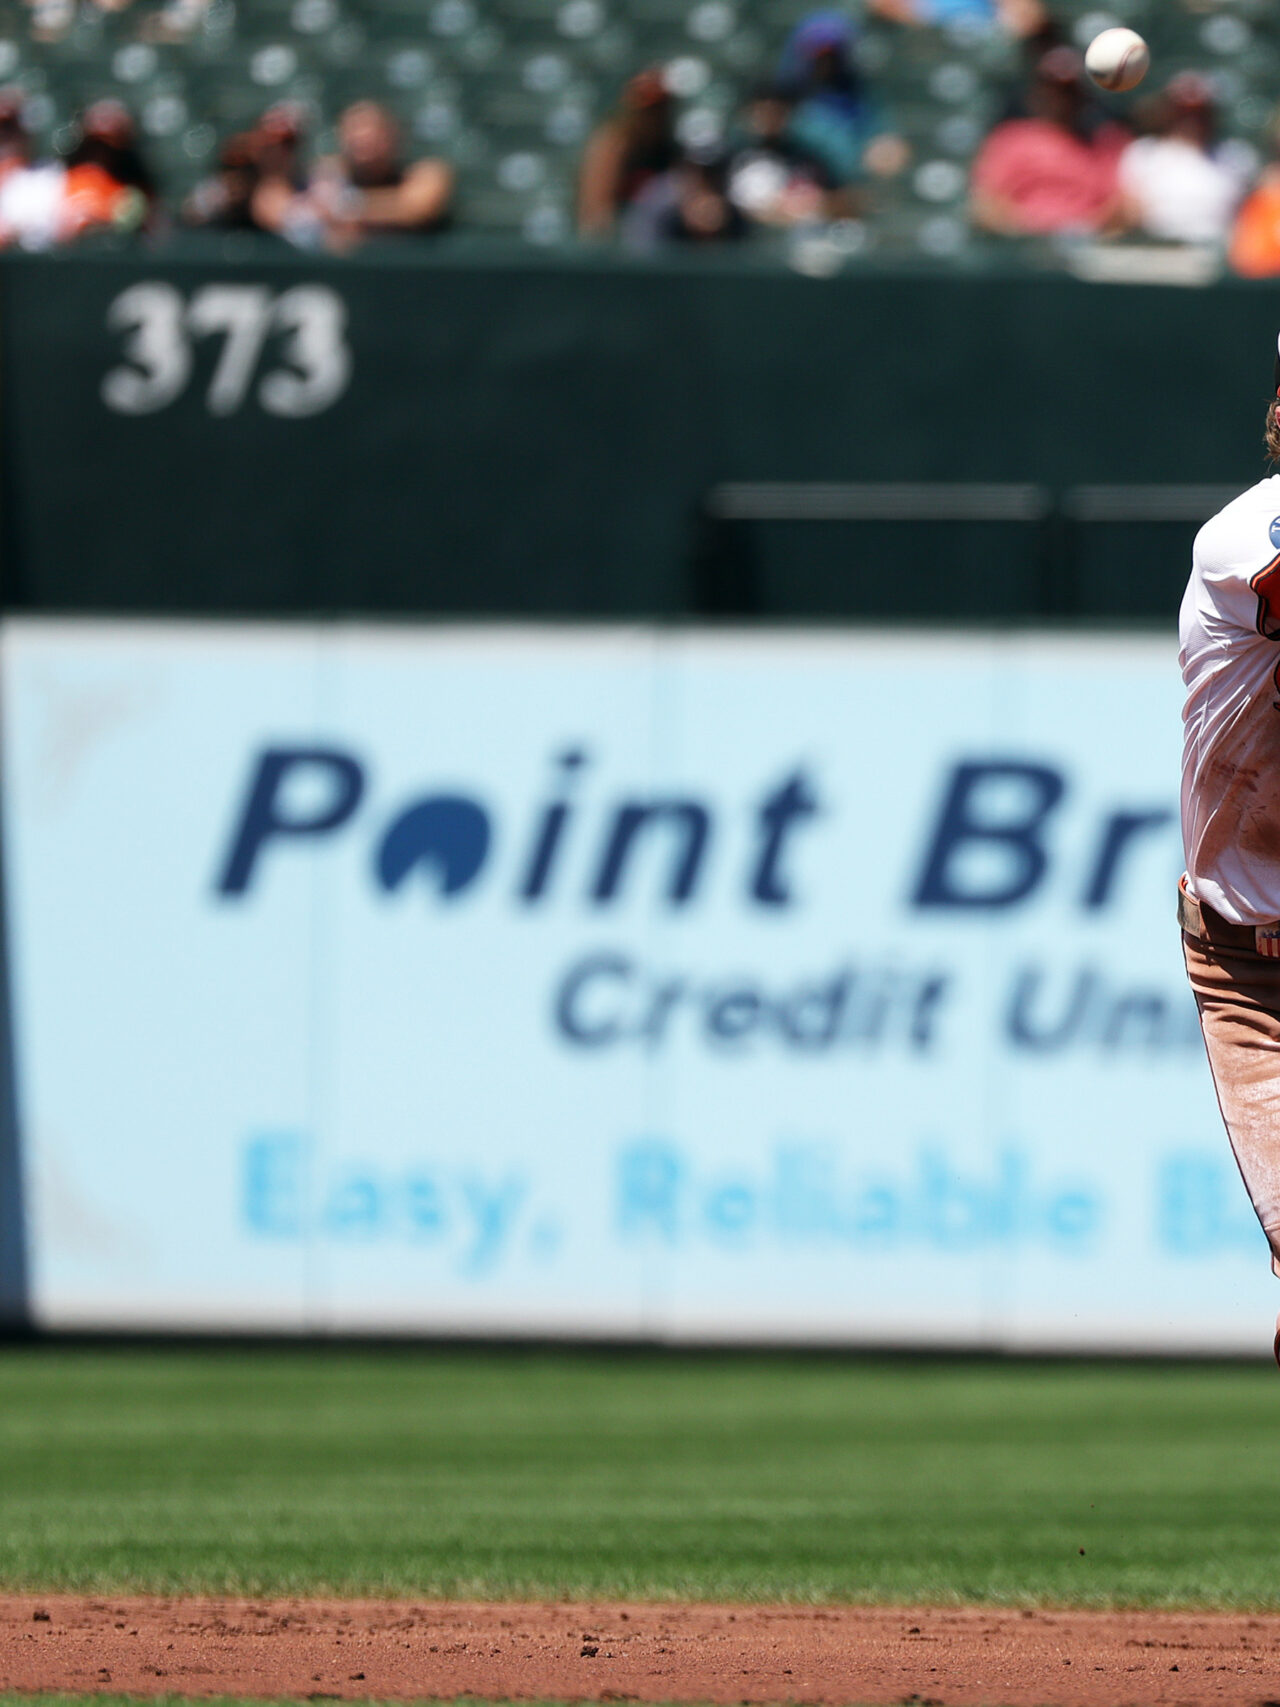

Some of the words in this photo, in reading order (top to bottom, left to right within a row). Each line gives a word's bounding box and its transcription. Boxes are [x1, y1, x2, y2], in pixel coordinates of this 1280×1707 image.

[104, 281, 351, 417] 373
[211, 741, 822, 908] Point
[550, 946, 952, 1054] Credit
[238, 1129, 564, 1279] Easy,
[613, 1131, 1104, 1255] Reliable
